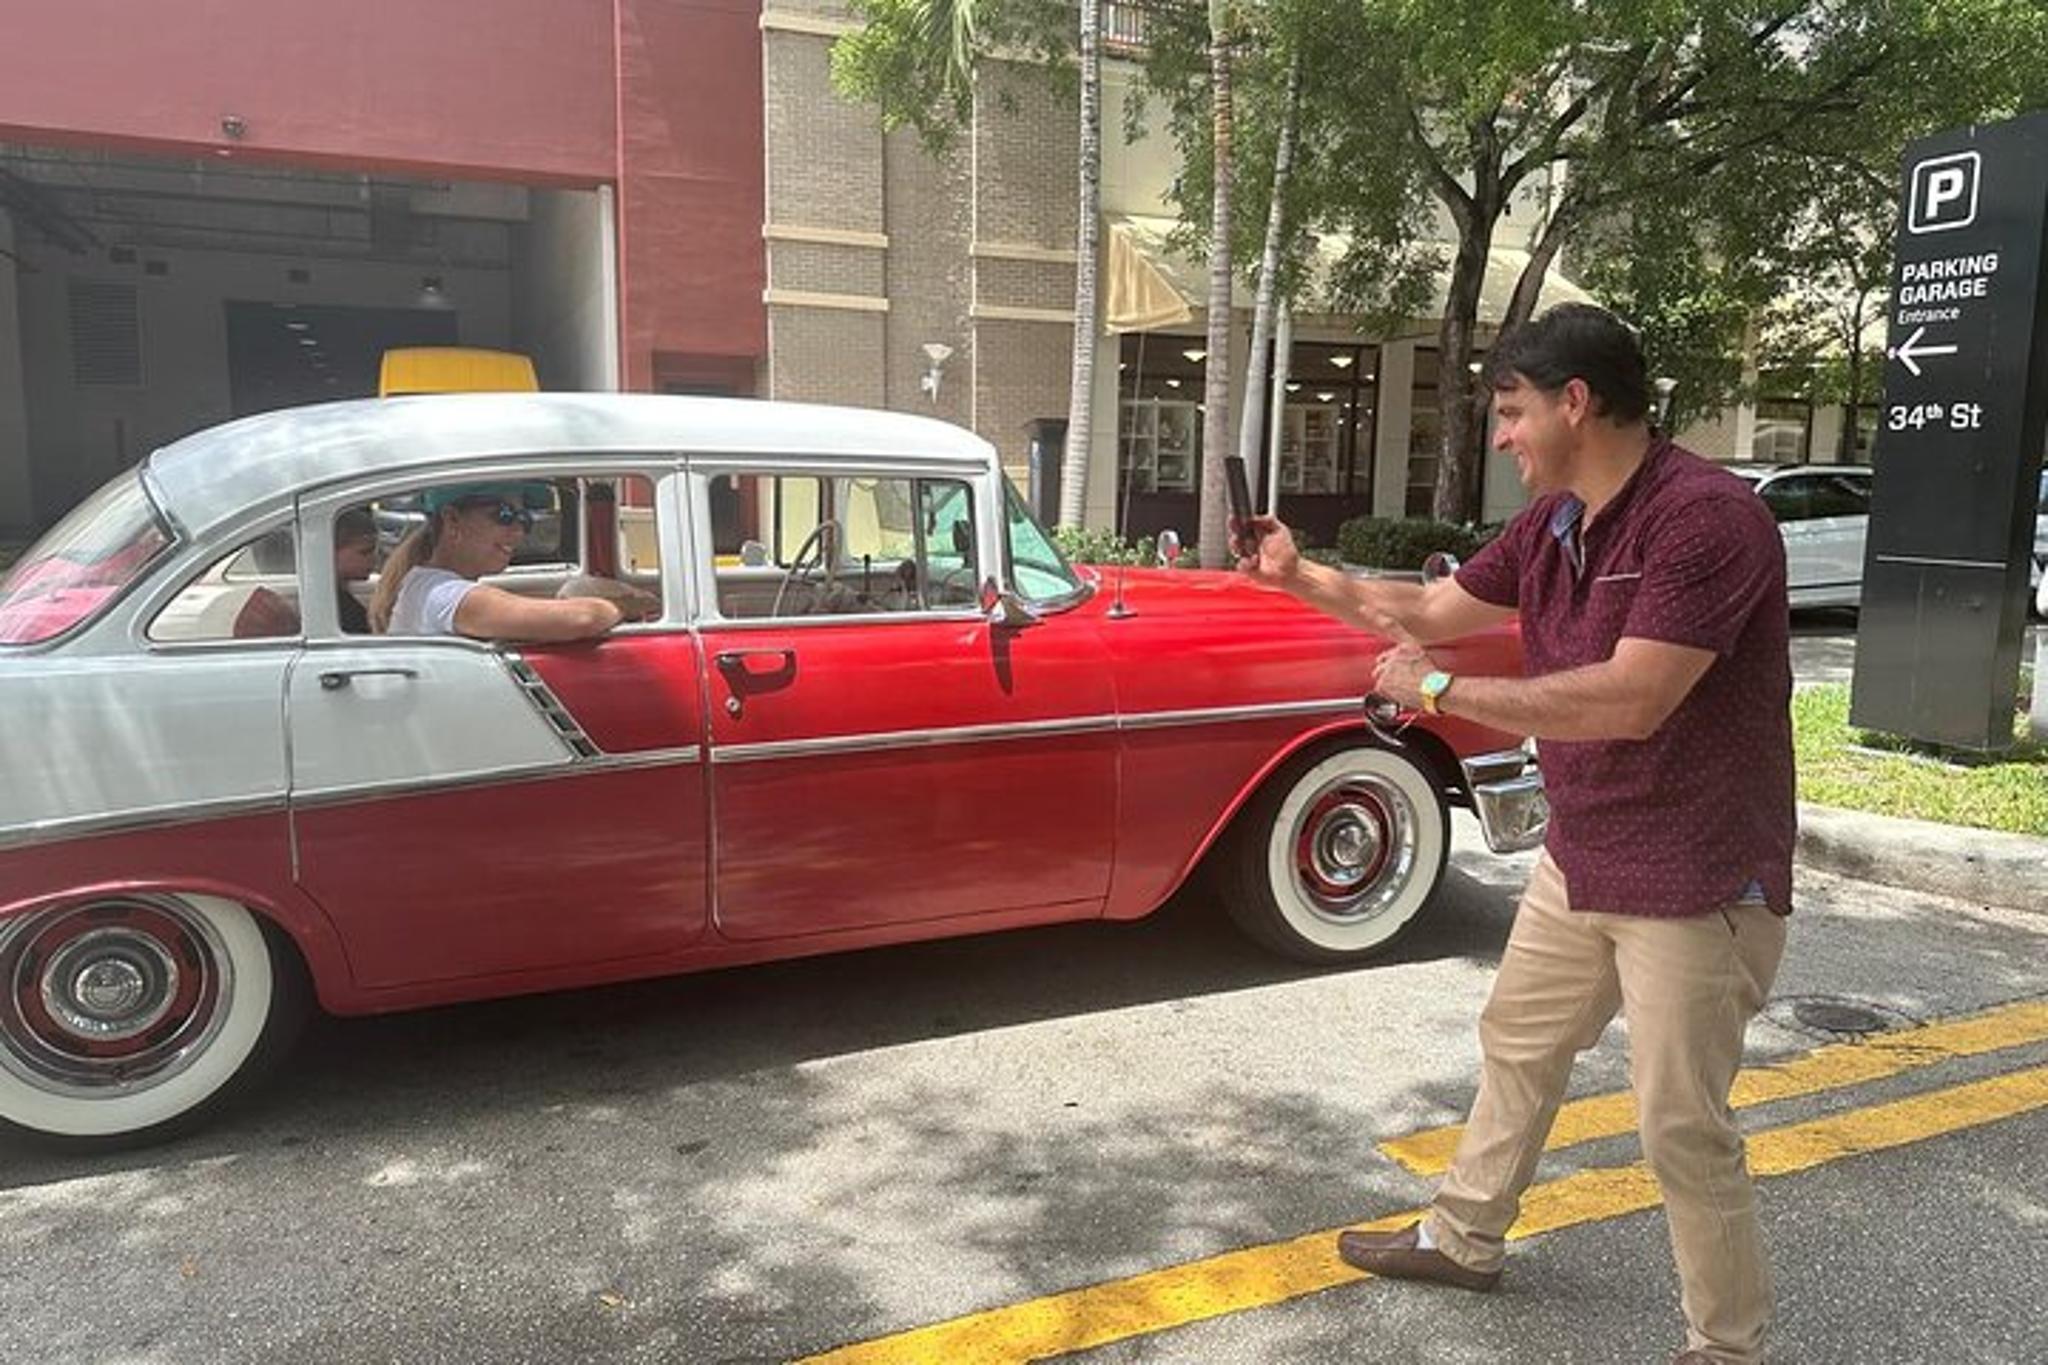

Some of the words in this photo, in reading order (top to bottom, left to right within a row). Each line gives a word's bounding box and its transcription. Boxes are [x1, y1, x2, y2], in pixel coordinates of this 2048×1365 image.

[1925, 167, 1964, 220] P
[1901, 253, 1999, 283] PARKING
[1899, 277, 1989, 305] GARAGE
[1897, 306, 1961, 325] Entrance
[1887, 404, 1944, 431] 34th
[1949, 402, 1983, 429] St
